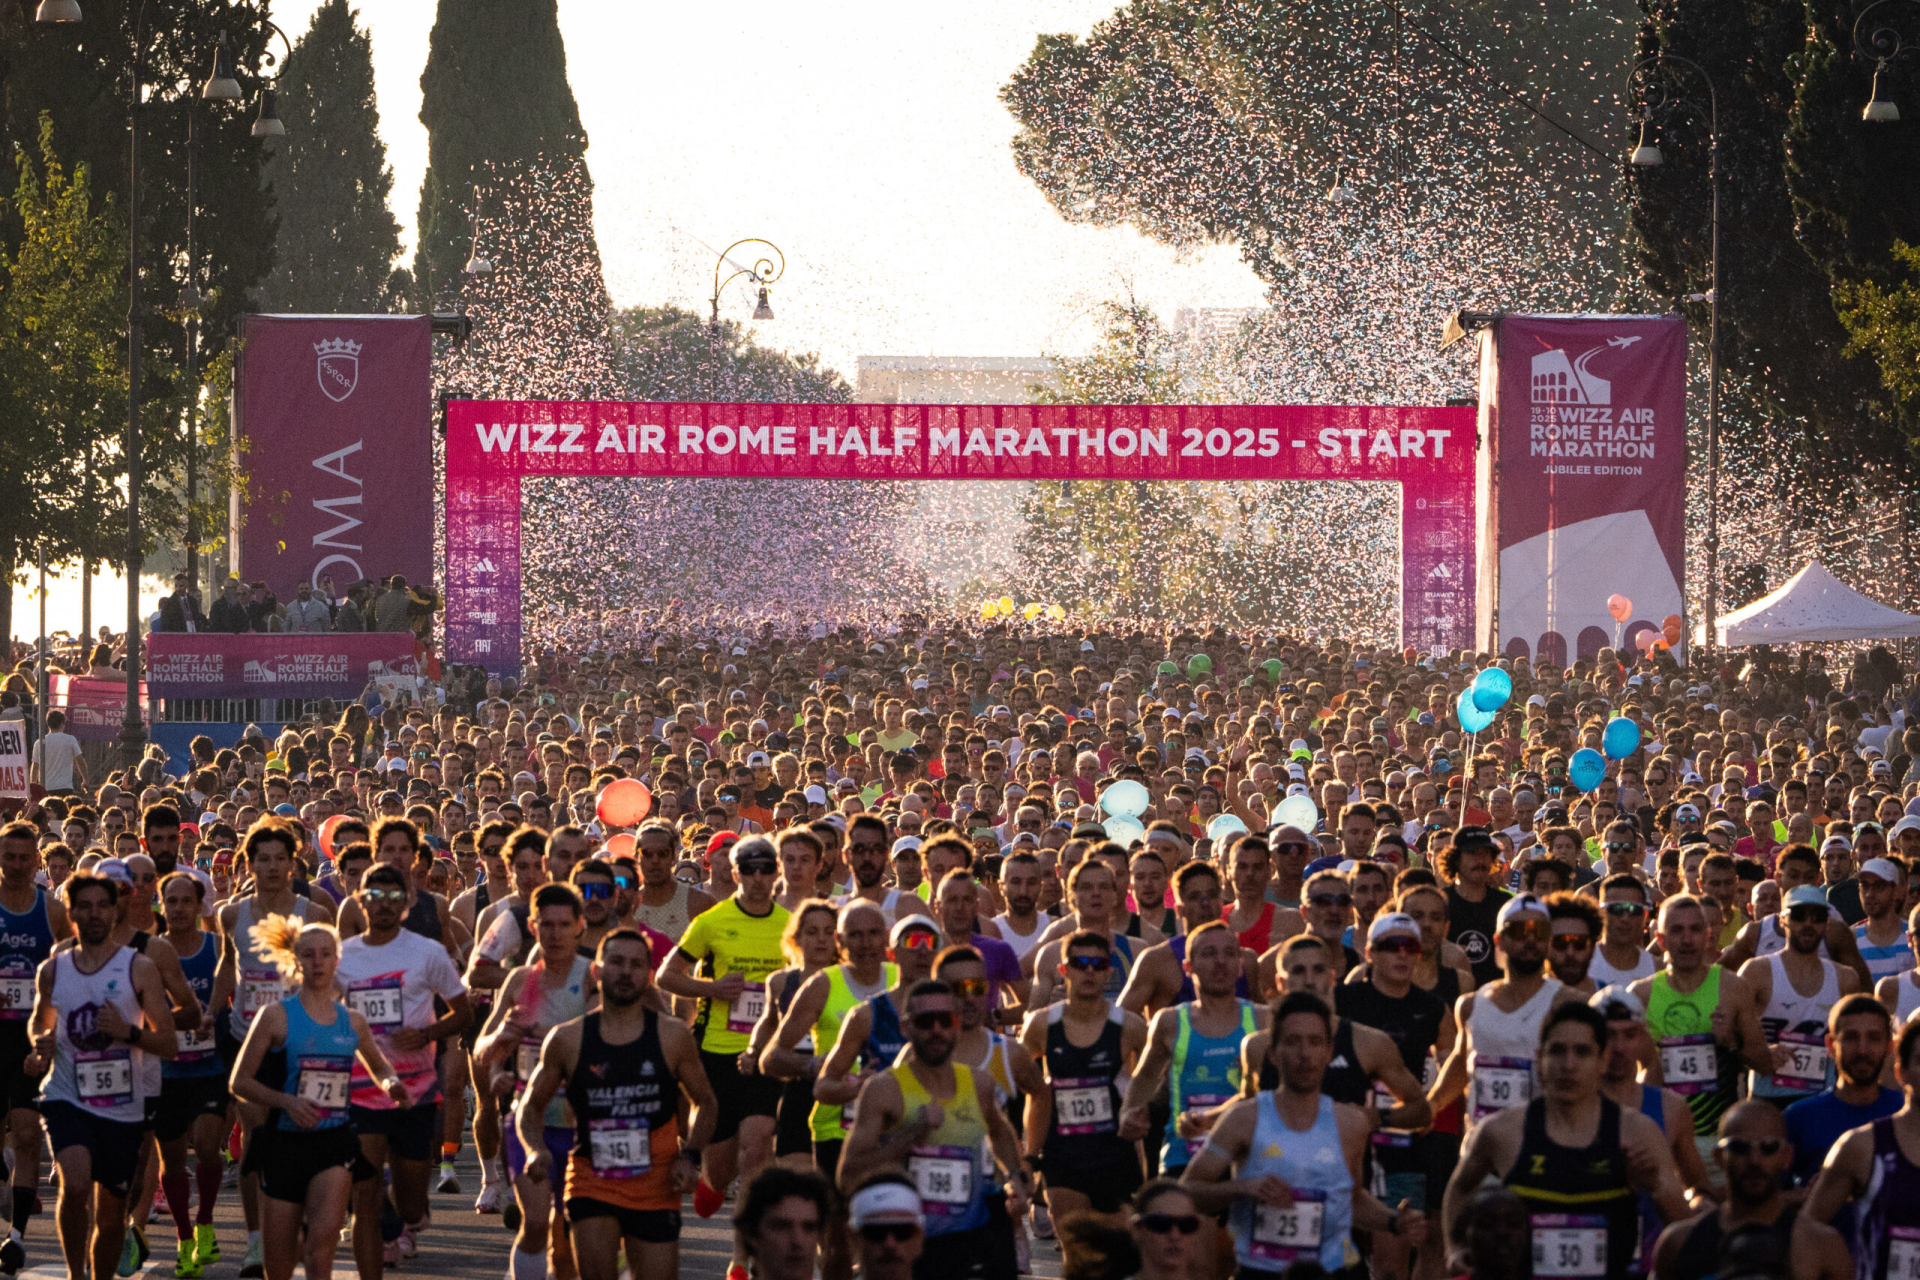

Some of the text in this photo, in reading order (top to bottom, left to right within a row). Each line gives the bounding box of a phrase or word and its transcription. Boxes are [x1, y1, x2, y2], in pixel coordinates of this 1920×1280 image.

[326, 365, 351, 387] SPQR
[1530, 414, 1557, 422] 2025
[1558, 407, 1613, 423] WIZZ
[1619, 408, 1655, 424] AIR
[475, 423, 584, 452] WIZZ
[594, 424, 666, 453] AIR
[678, 425, 796, 455] ROME
[809, 426, 916, 456] HALF
[929, 427, 1168, 457] MARATHON
[1181, 427, 1280, 457] 2025
[1317, 428, 1451, 458] START
[1530, 424, 1655, 441] ROME HALF
[1530, 441, 1655, 458] MARATHON
[1543, 465, 1642, 475] JUBILEE EDITION
[312, 437, 364, 606] OMA
[475, 639, 492, 653] FIAT
[168, 654, 224, 663] WIZZ AIR
[293, 654, 348, 663] WIZZ AIR
[153, 663, 224, 673] ROME HALF
[278, 663, 349, 673] ROME HALF
[153, 673, 224, 682] MARATHON
[278, 673, 349, 682] MARATHON
[364, 1000, 386, 1017] 103
[1680, 1057, 1697, 1074] 45
[96, 1072, 112, 1089] 56
[318, 1083, 332, 1100] 72
[587, 1083, 660, 1099] VALENCIA
[1492, 1081, 1510, 1100] 90
[1071, 1098, 1095, 1117] 120
[1278, 1214, 1299, 1237] 25
[1559, 1243, 1582, 1267] 30
